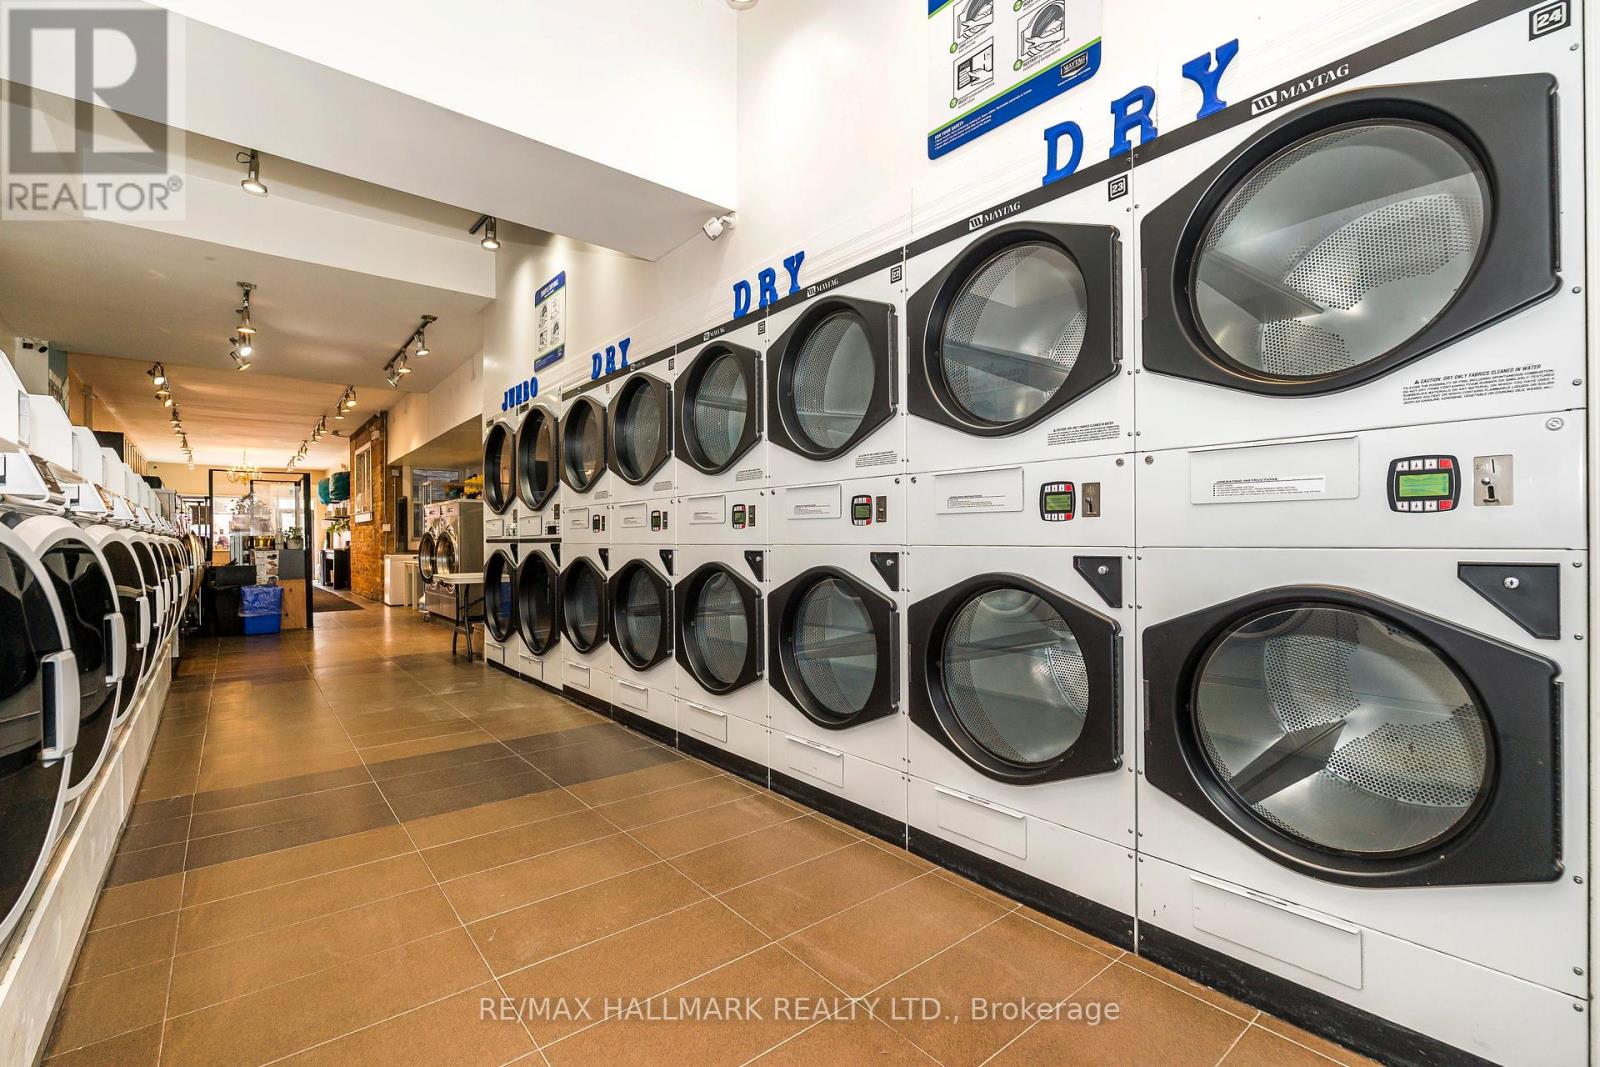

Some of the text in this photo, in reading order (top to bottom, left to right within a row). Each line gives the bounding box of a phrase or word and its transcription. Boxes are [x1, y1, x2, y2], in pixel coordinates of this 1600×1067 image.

[1536, 8, 1562, 28] 24
[1280, 63, 1349, 102] MAYTAG
[1043, 38, 1239, 185] DRY
[1111, 180, 1125, 193] 23
[984, 201, 1021, 223] MAYTAG
[732, 250, 805, 320] DRY
[591, 337, 631, 380] DRY
[501, 376, 538, 412] JUMBO
